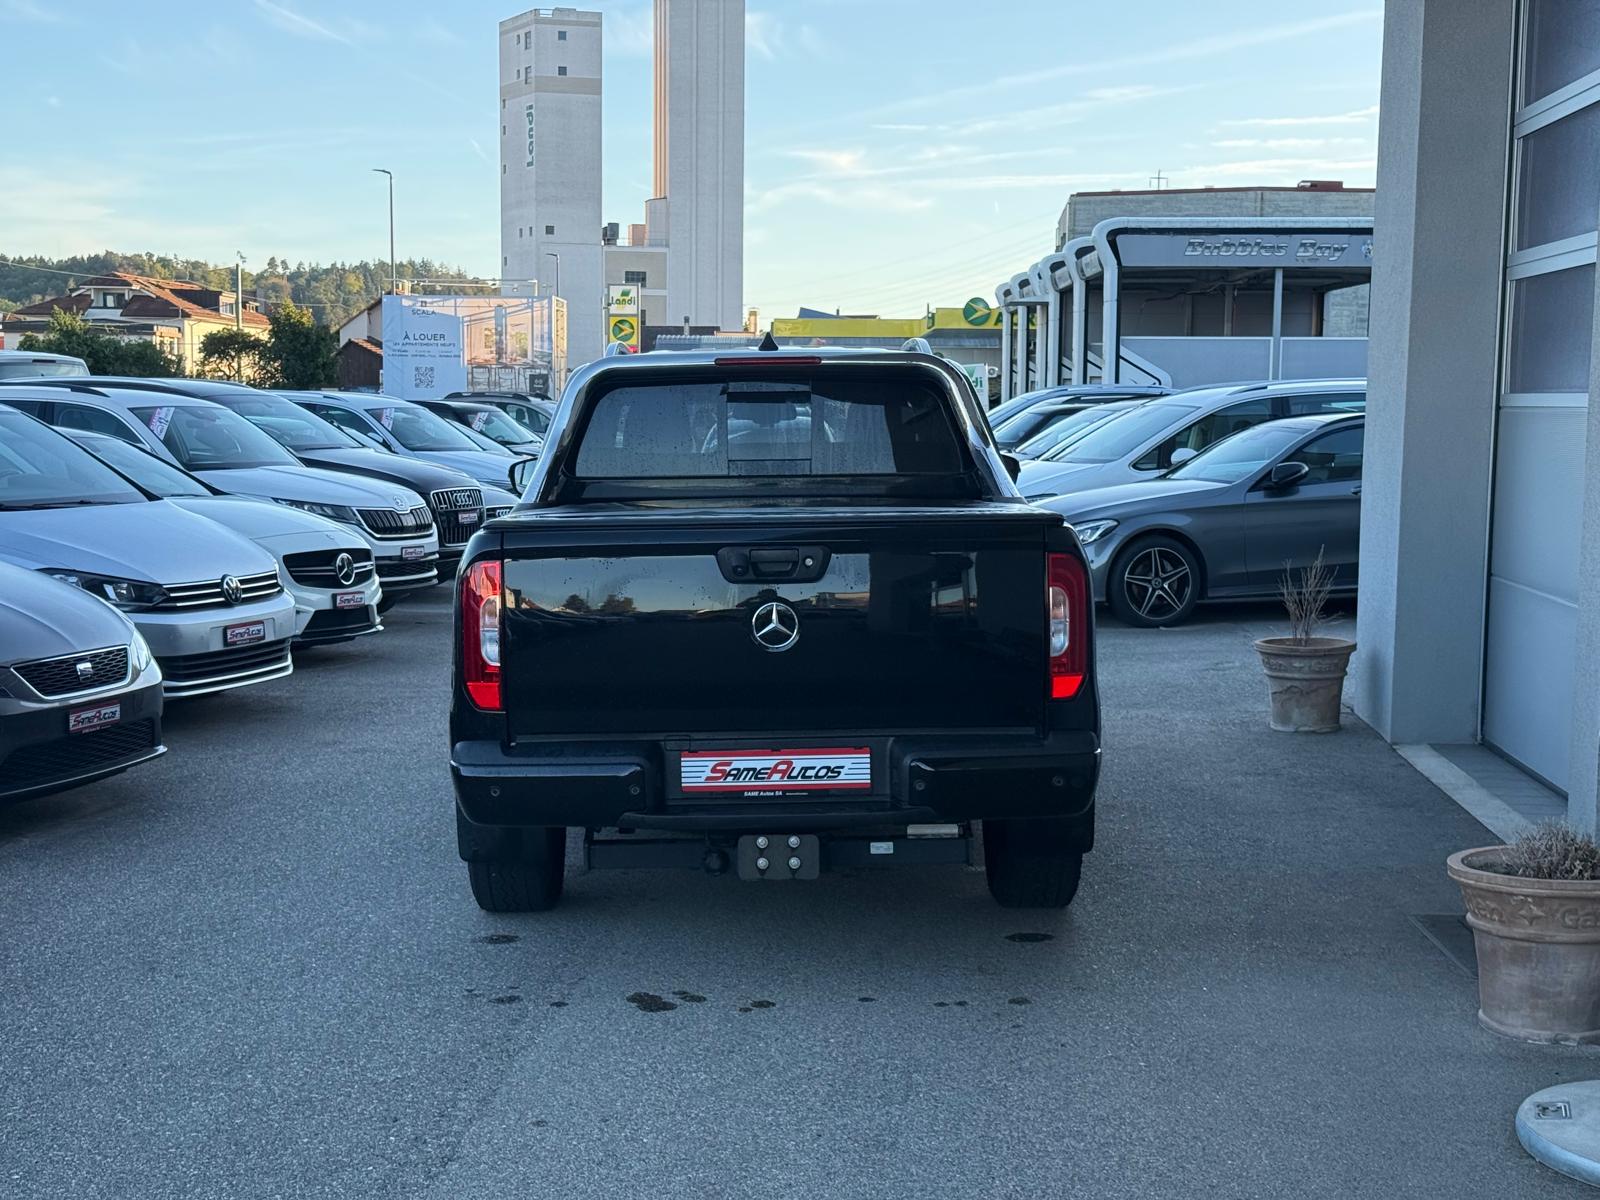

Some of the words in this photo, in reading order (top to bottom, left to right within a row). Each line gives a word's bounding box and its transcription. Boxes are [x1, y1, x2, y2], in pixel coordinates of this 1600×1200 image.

[1184, 239, 1289, 256] Bubbles
[1296, 239, 1349, 261] Bay
[403, 331, 411, 341] À
[413, 333, 446, 341] LOUER
